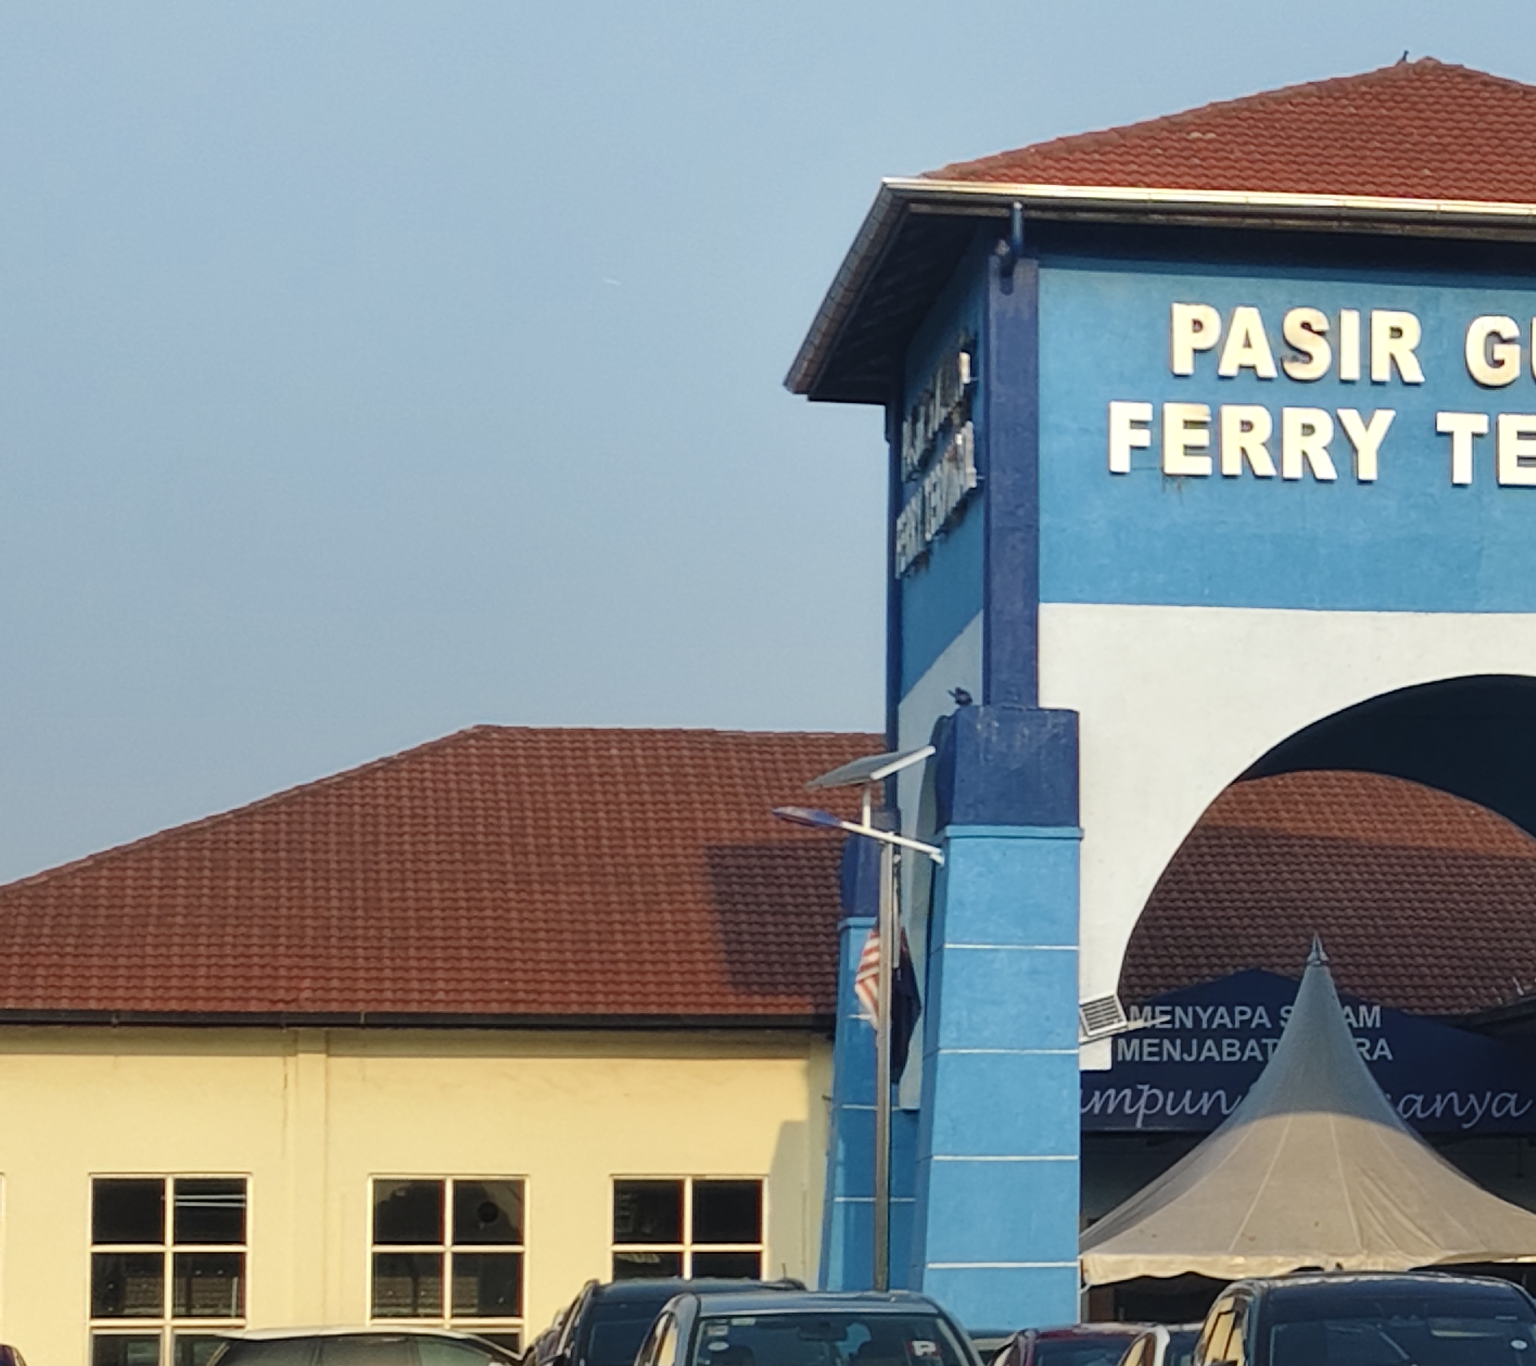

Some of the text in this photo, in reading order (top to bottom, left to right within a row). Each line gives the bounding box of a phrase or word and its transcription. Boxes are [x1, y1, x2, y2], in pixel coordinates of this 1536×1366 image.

[1171, 302, 1426, 383] PASIR
[1108, 401, 1397, 481] FERRY
[1129, 1006, 1272, 1029] MENYAPA
[1117, 1038, 1280, 1062] MENJABAT
